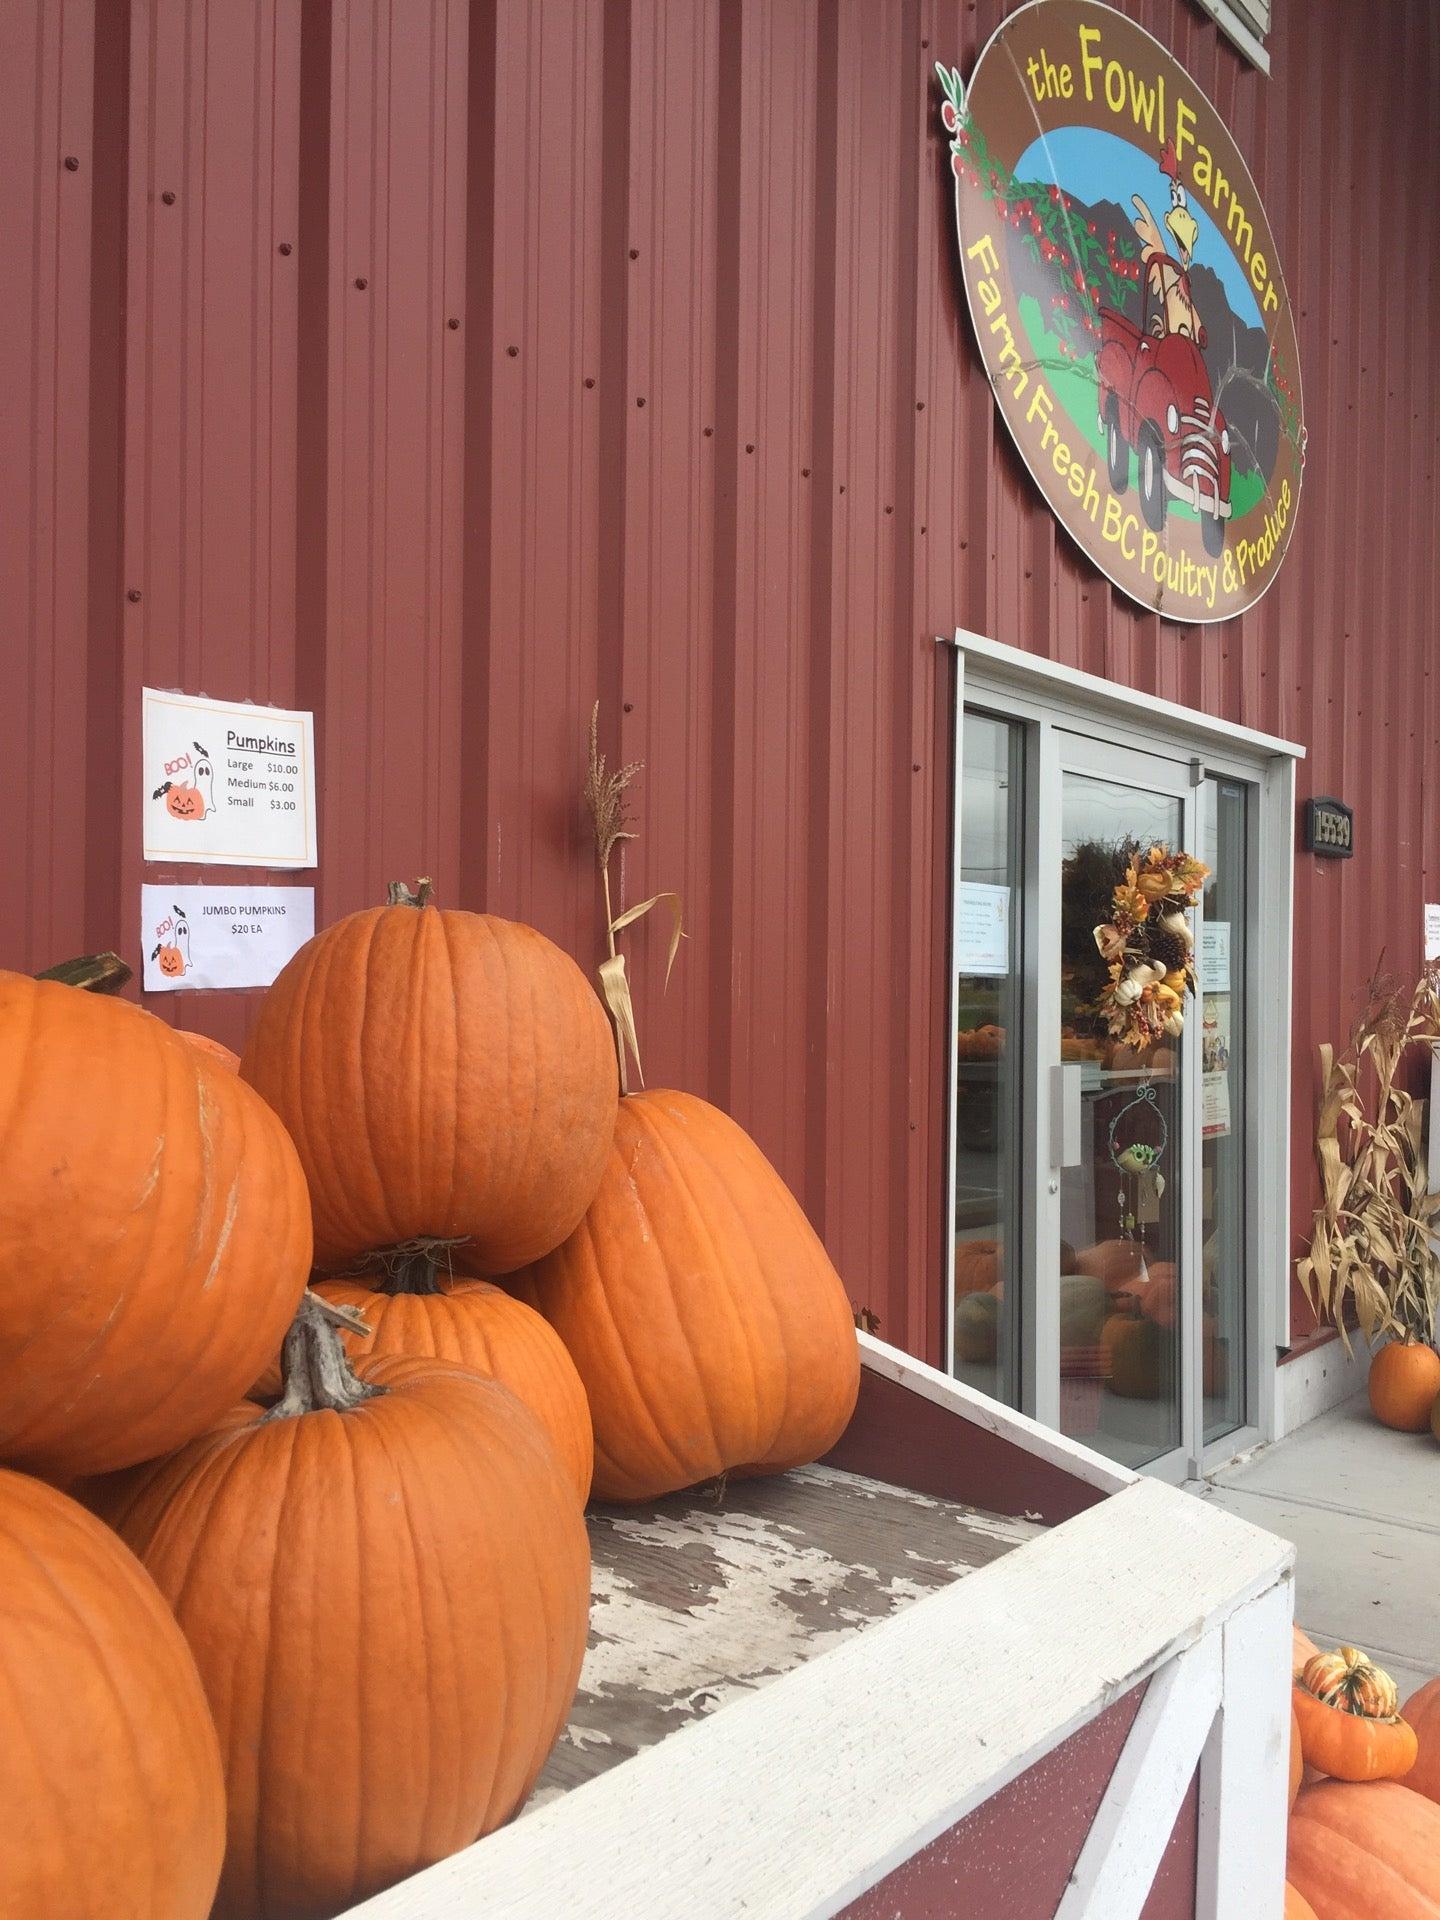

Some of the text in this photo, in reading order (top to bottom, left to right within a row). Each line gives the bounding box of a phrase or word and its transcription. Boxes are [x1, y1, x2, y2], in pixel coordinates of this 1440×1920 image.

[1026, 24, 1278, 312] the Fowl Farmer
[967, 235, 1292, 608] Farm Fresh BC Poultry & Produce
[227, 730, 296, 755] Pumpkins
[164, 752, 193, 776] BOO!
[227, 758, 298, 775] Large $10.00
[227, 778, 294, 793] Medium $6.00
[227, 797, 296, 811] Small $3.00
[202, 905, 287, 916] JUMBO PUMPKINS
[231, 924, 263, 935] $20 EA
